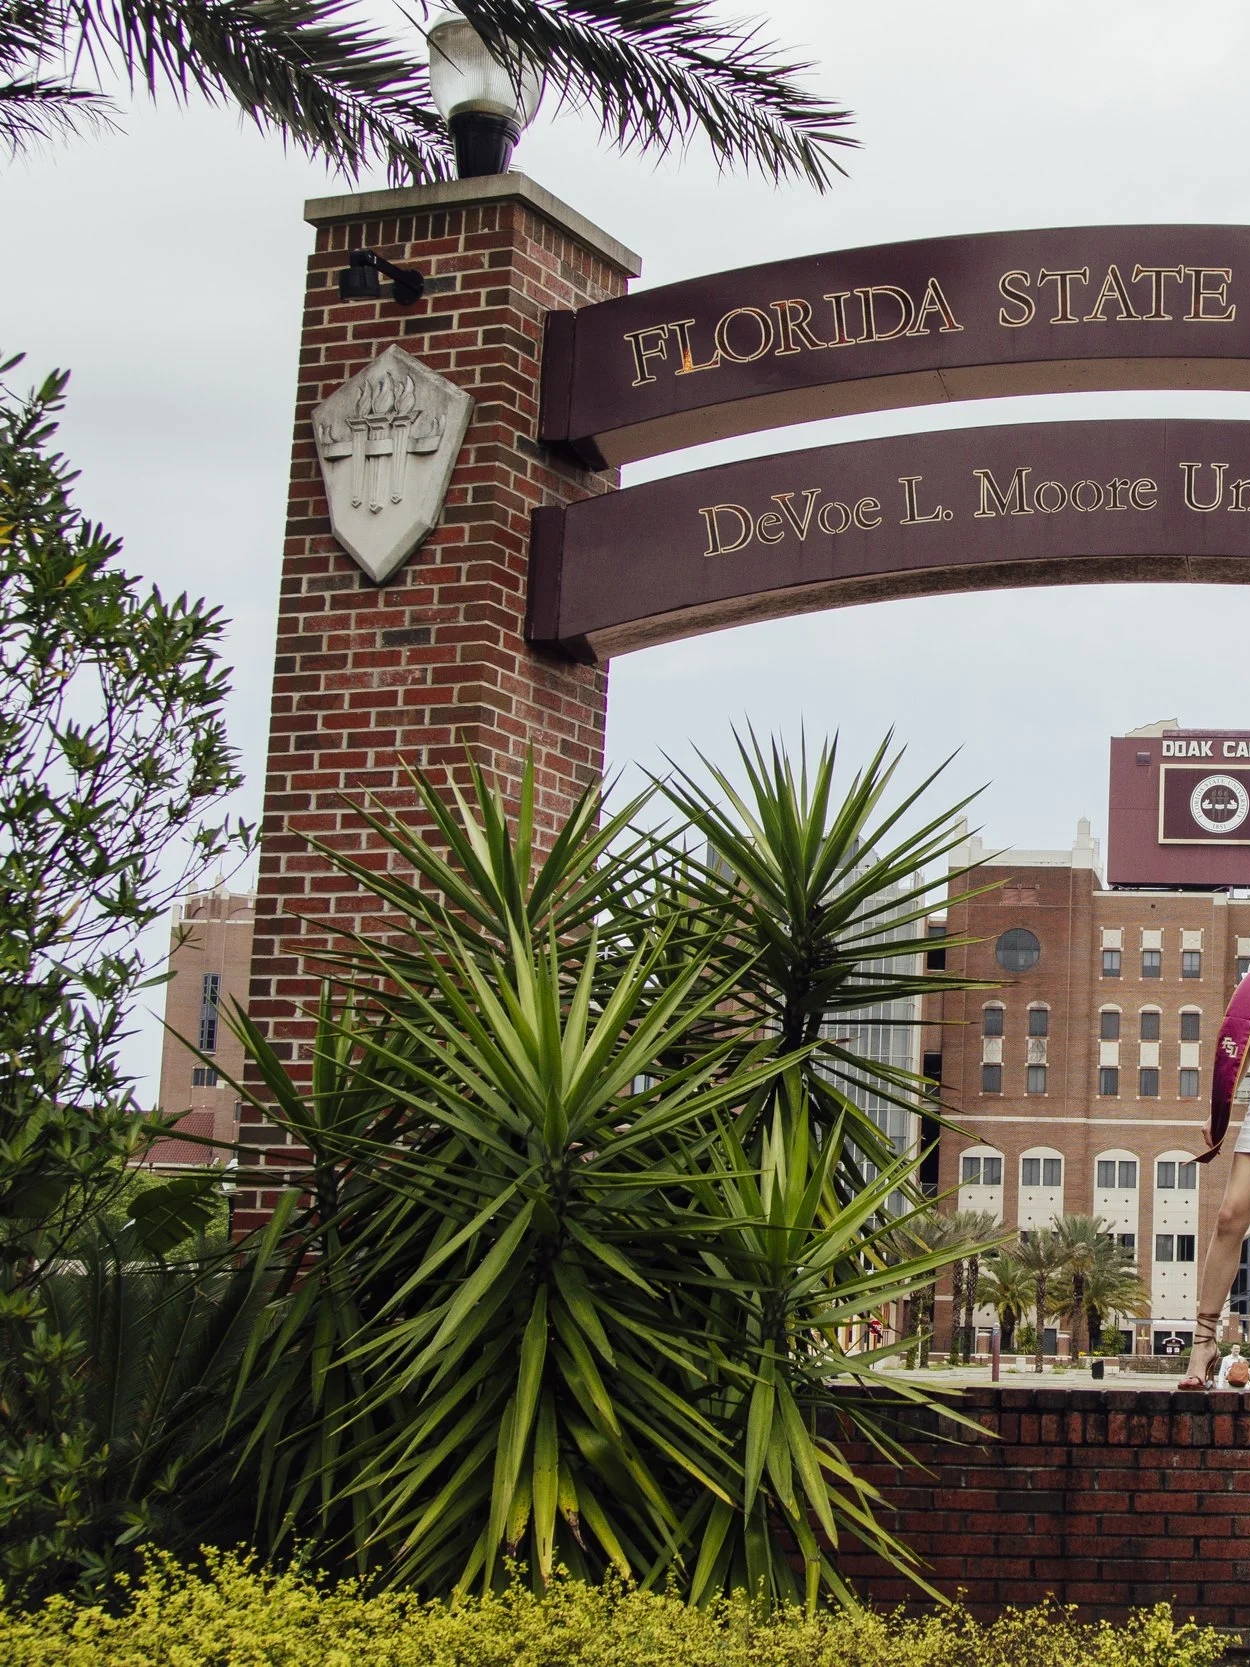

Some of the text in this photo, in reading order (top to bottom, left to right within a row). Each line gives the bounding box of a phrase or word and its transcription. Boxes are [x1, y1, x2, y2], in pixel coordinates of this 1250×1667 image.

[624, 277, 964, 387] FLORIDA
[998, 264, 1237, 328] STATE
[699, 488, 882, 557] DeVoe
[898, 476, 954, 526] L.
[973, 467, 1158, 519] Moore
[1162, 740, 1214, 757] DOAK
[1193, 778, 1246, 819] FLORIDA STATE UNIVERSITY
[1221, 1036, 1239, 1058] FSU
